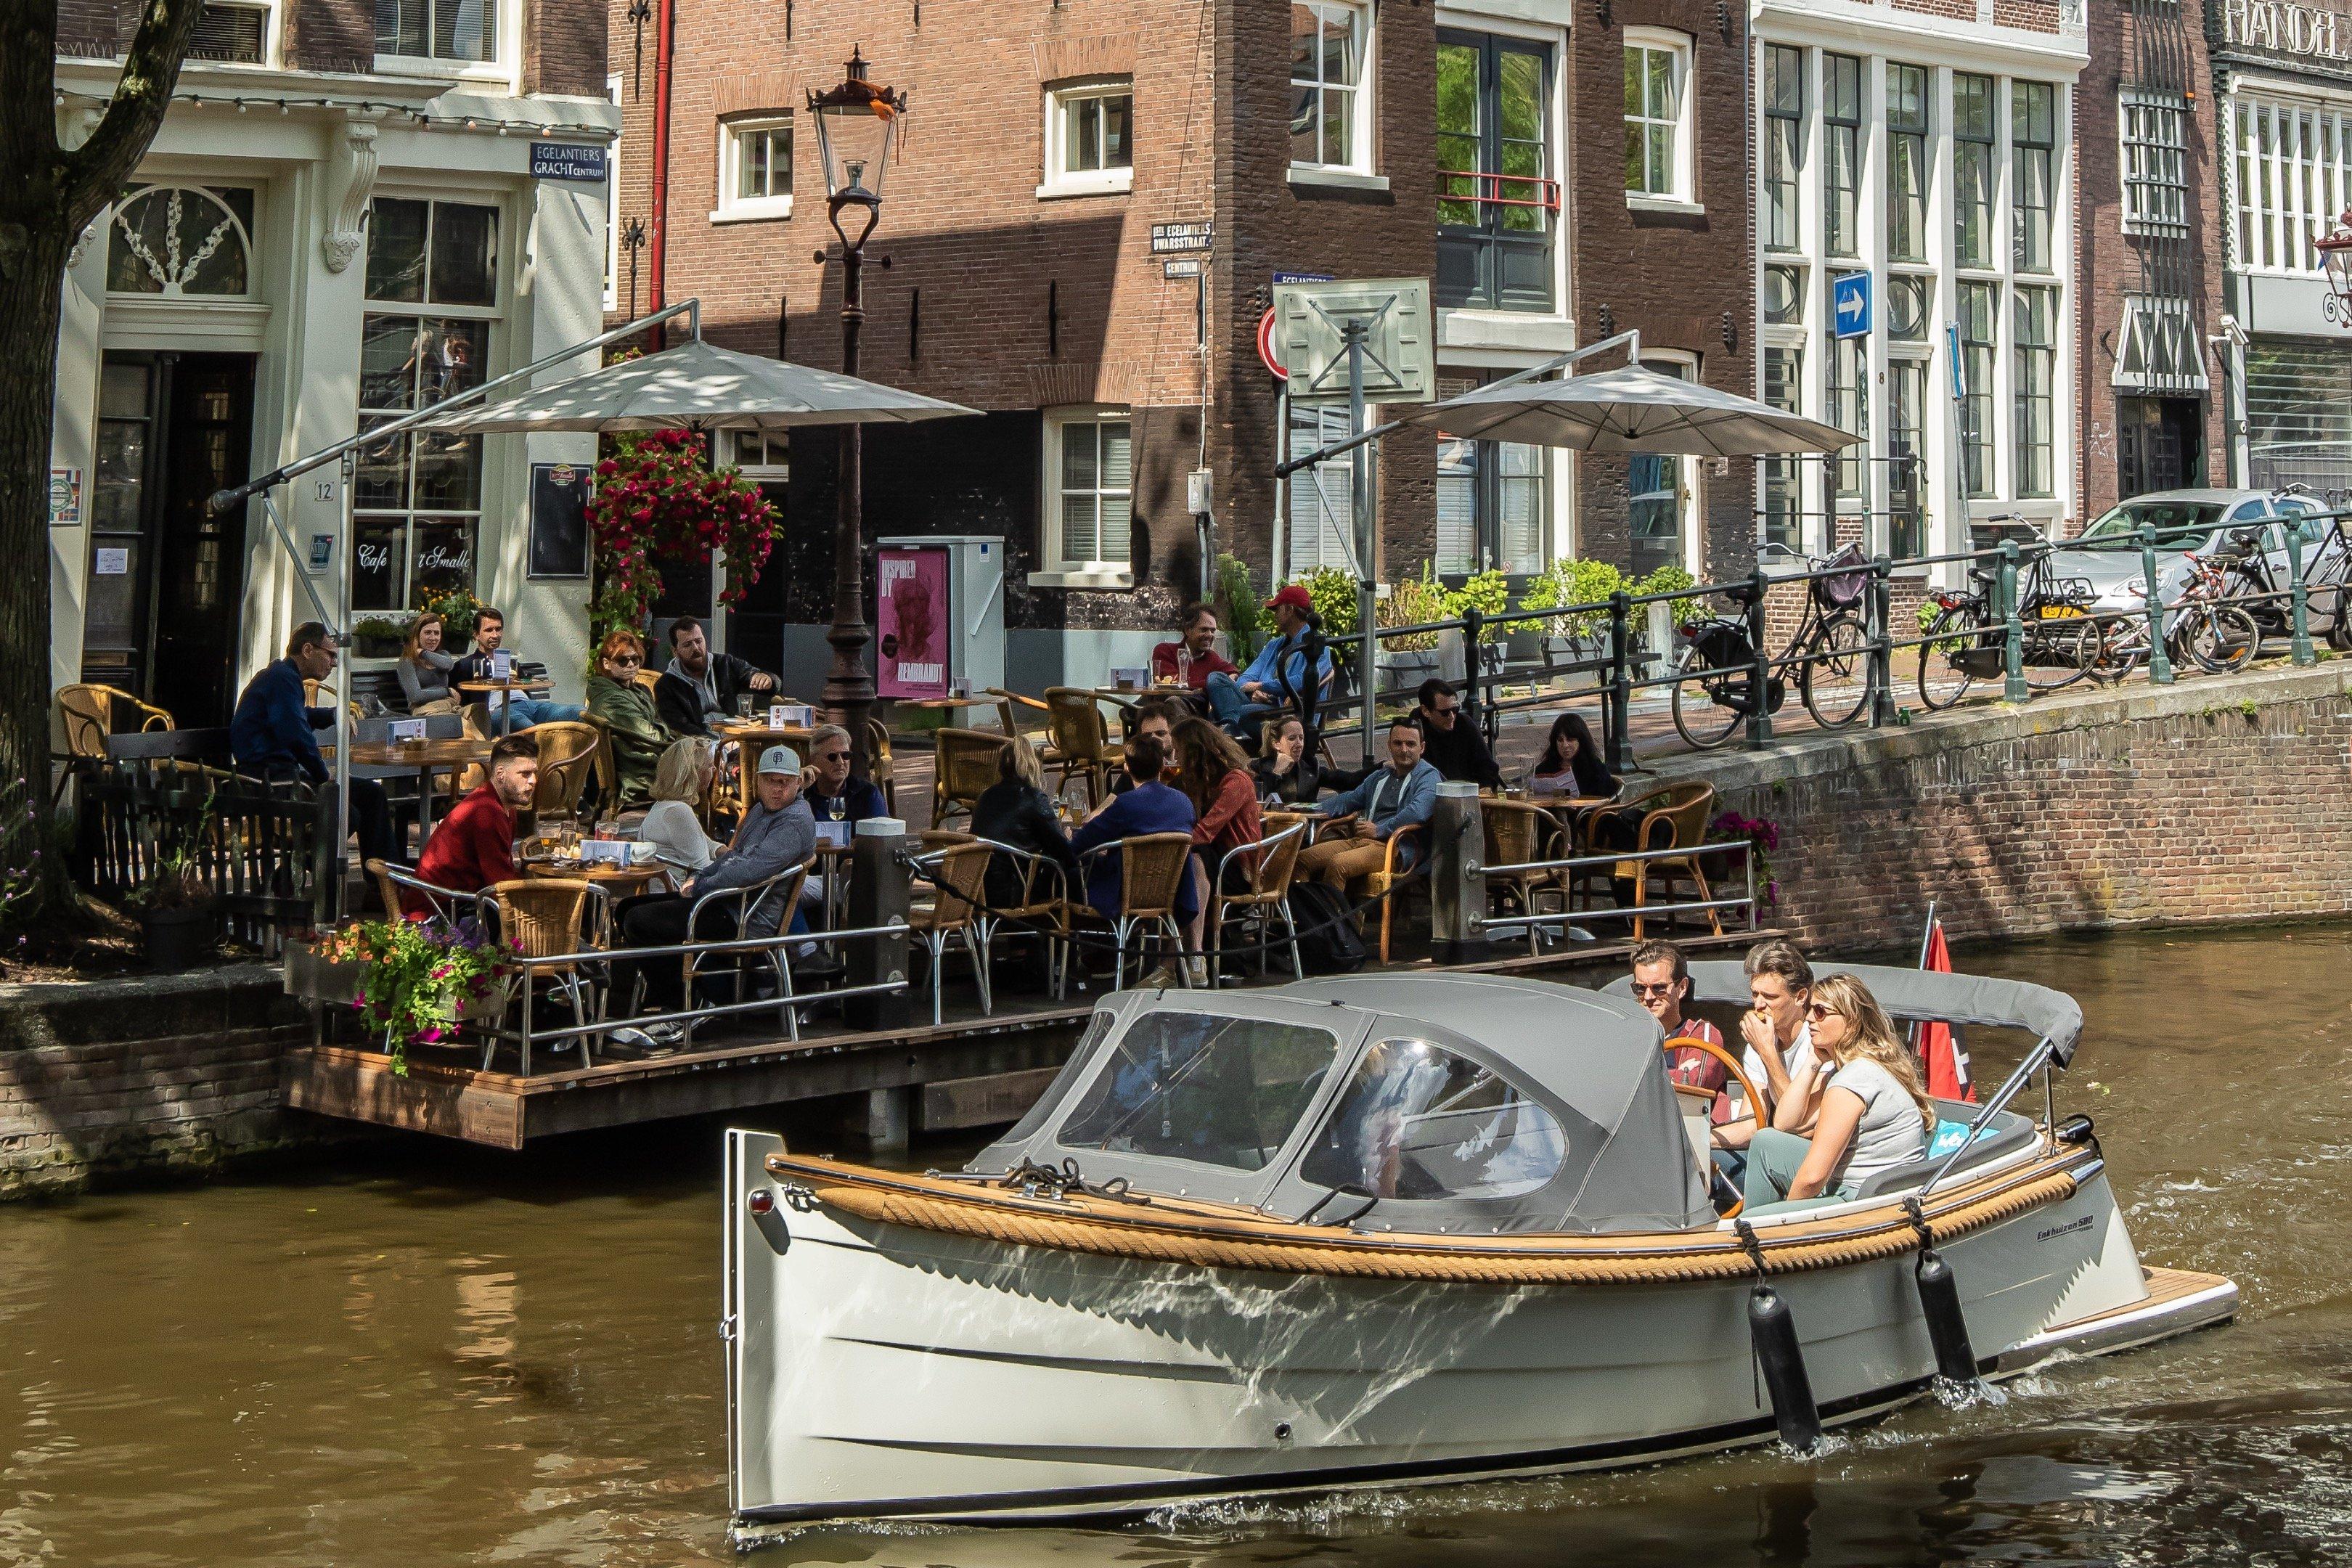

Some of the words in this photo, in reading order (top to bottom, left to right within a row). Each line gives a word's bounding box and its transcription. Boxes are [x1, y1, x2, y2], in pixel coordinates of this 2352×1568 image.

[2225, 0, 2349, 60] HANDEL
[537, 147, 600, 161] EGELANTIERS
[1166, 261, 1198, 274] CENTRUM
[1879, 372, 1885, 384] 8
[318, 483, 331, 499] 12
[426, 546, 470, 568] Smalle
[881, 560, 915, 579] INSPIRED
[898, 662, 943, 682] REMBRANDT
